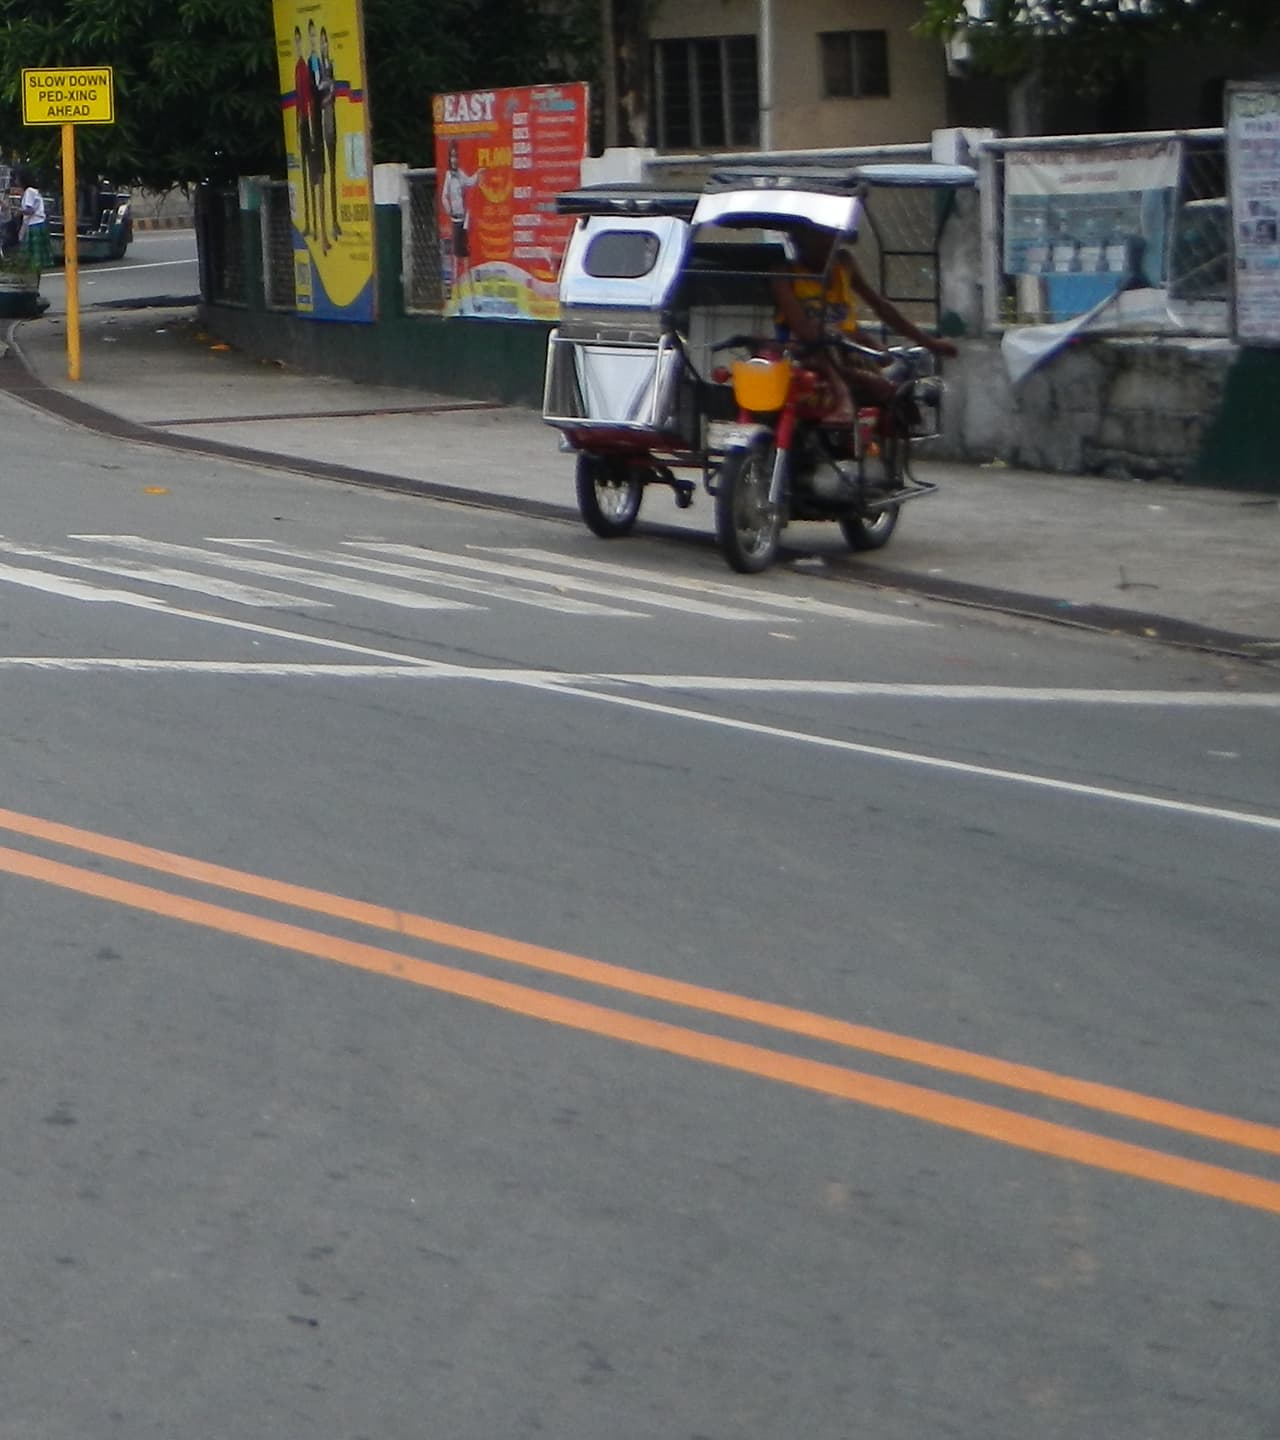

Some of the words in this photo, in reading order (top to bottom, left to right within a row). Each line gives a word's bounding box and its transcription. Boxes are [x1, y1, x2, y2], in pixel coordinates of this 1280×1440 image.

[29, 76, 65, 88] SLOW
[69, 75, 107, 87] DOWN
[39, 90, 97, 102] PED-XING
[47, 105, 90, 117] AHEAD
[444, 93, 495, 122] EAST
